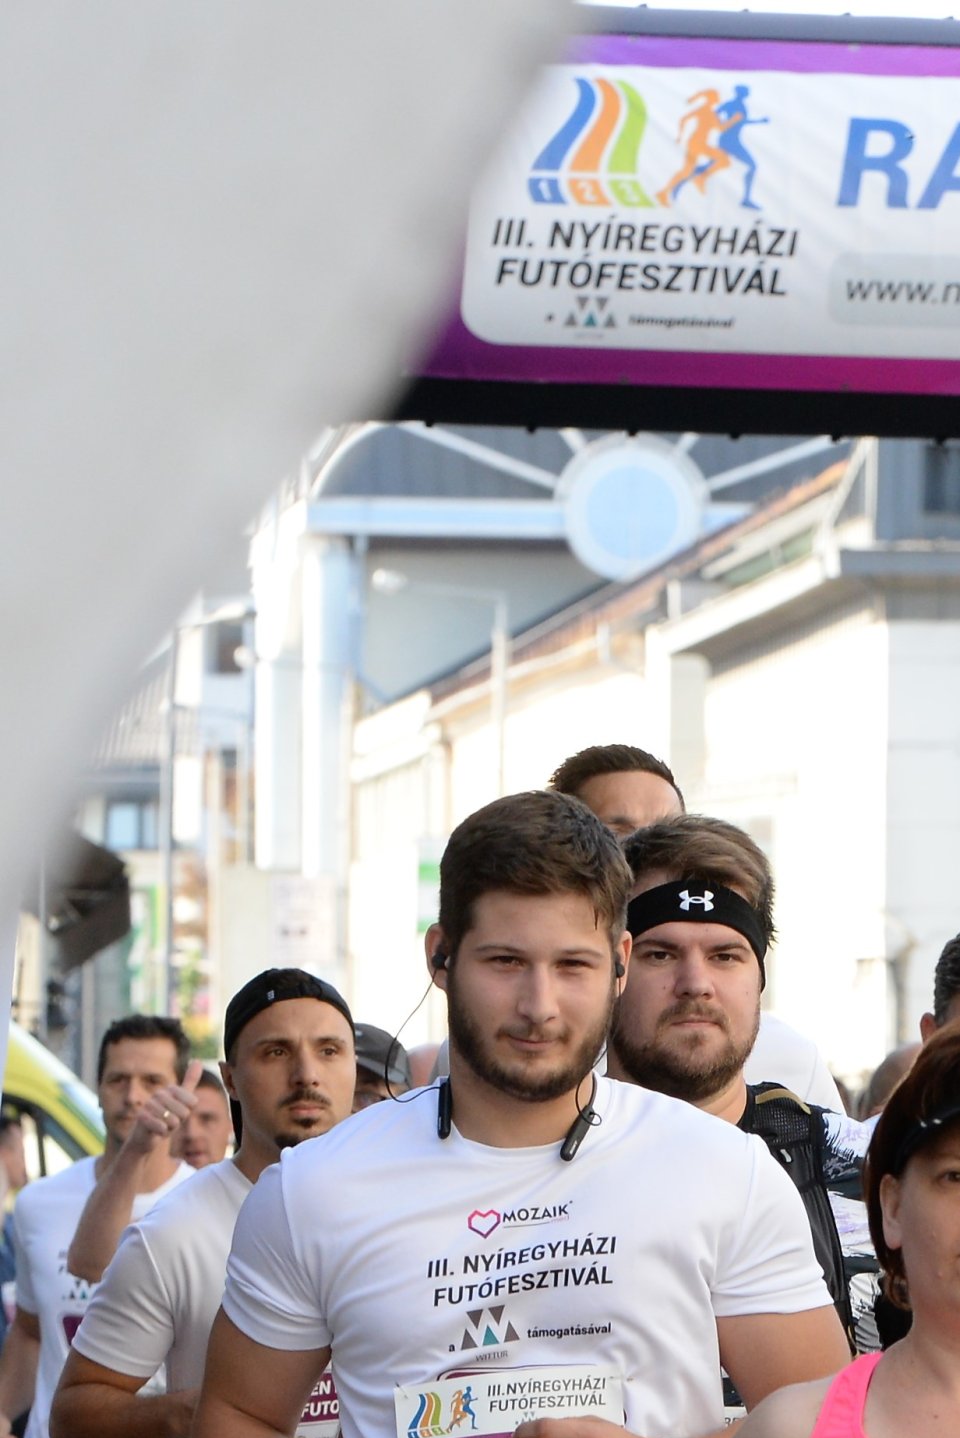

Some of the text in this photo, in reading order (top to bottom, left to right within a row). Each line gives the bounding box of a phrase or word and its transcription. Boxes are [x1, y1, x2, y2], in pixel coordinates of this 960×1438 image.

[491, 214, 800, 257] III. NYÍREGYHÁZI
[495, 248, 788, 298] FUTÓFESZTIVÁL
[502, 1204, 568, 1224] MOZAIK
[427, 1232, 617, 1279] III. NYÍREGYHÁZI
[433, 1261, 613, 1307] FUTÓFESZTIVÁL
[527, 1322, 611, 1340] támogatásával
[487, 1375, 607, 1397] III.NYÍREGYHÁZI
[489, 1394, 606, 1412] FUTÓFESZTIVÁL
